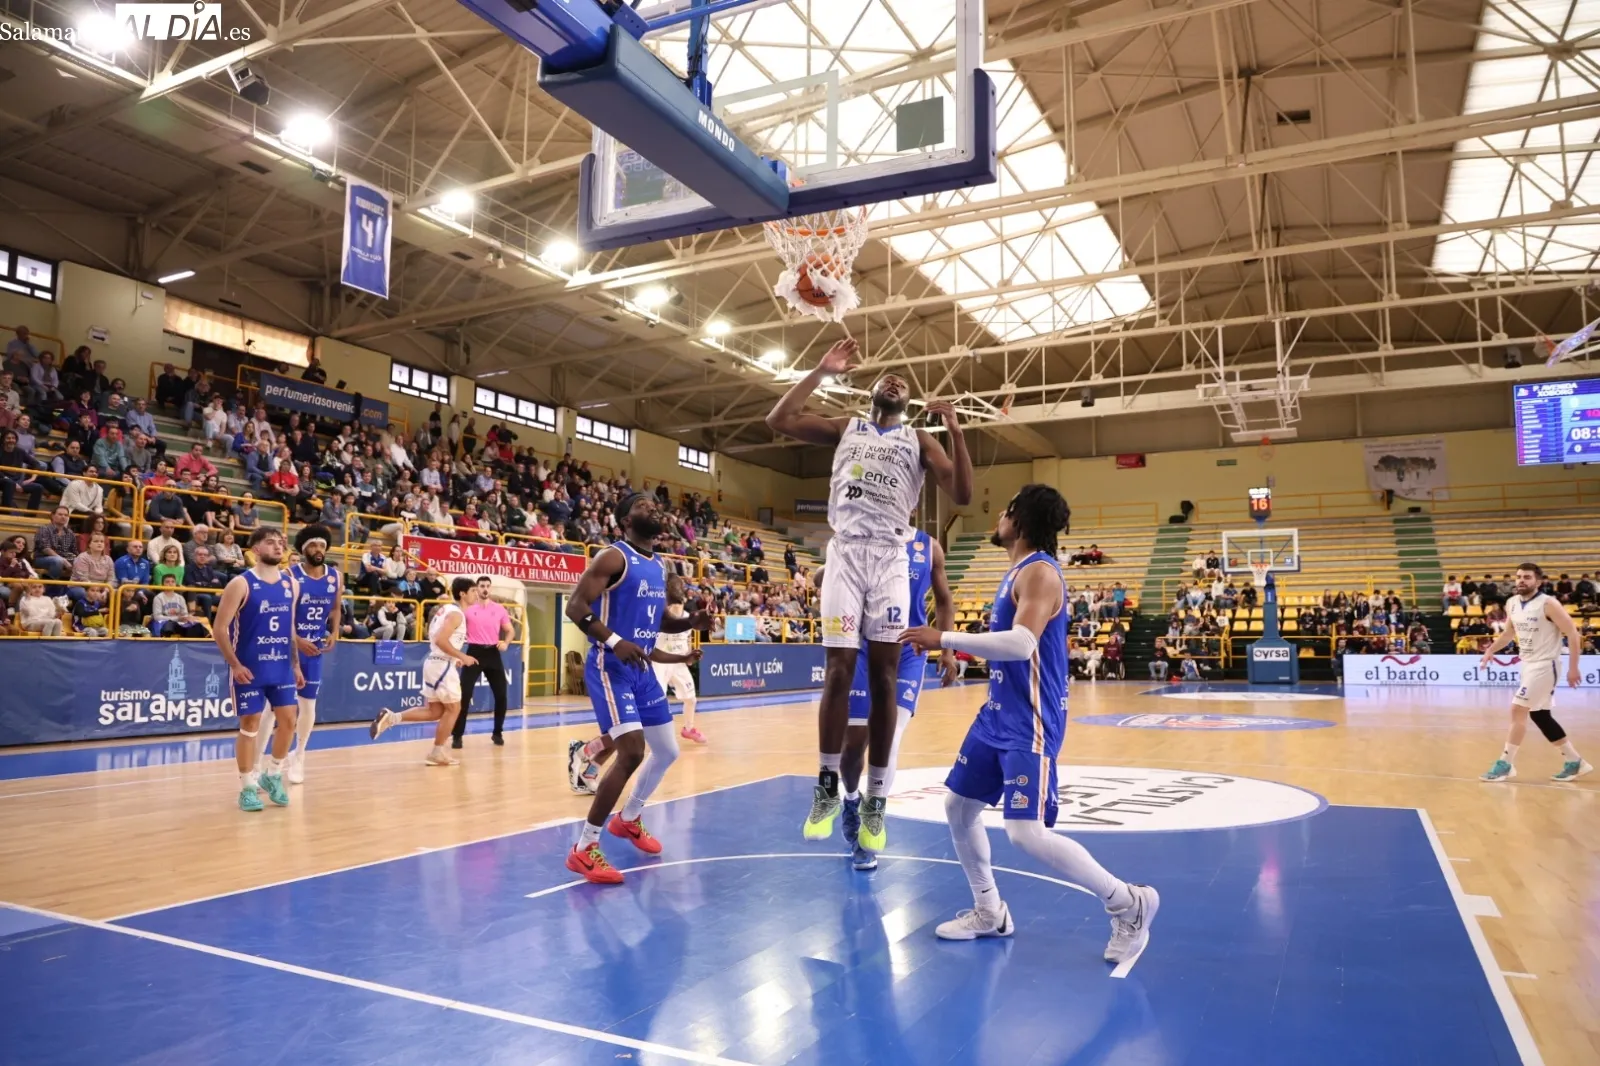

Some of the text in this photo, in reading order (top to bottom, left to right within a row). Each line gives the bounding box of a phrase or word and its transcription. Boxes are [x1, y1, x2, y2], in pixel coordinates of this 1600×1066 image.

[698, 109, 735, 152] MONDO
[361, 213, 373, 248] 4
[868, 445, 898, 456] XUNTA
[864, 451, 911, 471] DE GALICIA
[864, 471, 898, 488] ence
[1251, 498, 1268, 511] 16
[450, 543, 568, 570] SALAMANCA
[428, 558, 582, 583] PATRIMONIO DE LA HUMANIDAD
[306, 607, 323, 620] 22
[647, 605, 657, 624] 4
[886, 606, 901, 622] 12
[269, 616, 280, 632] 6
[297, 623, 320, 631] Xobor
[257, 636, 288, 645] Xoborg
[711, 658, 783, 677] CASTILLA Y LEÓN
[1364, 666, 1440, 681] el bardo
[1463, 667, 1521, 682] el bar
[354, 670, 421, 691] CASTIL
[101, 688, 150, 701] turismo
[1520, 686, 1527, 696] 5
[401, 697, 422, 708] NOS
